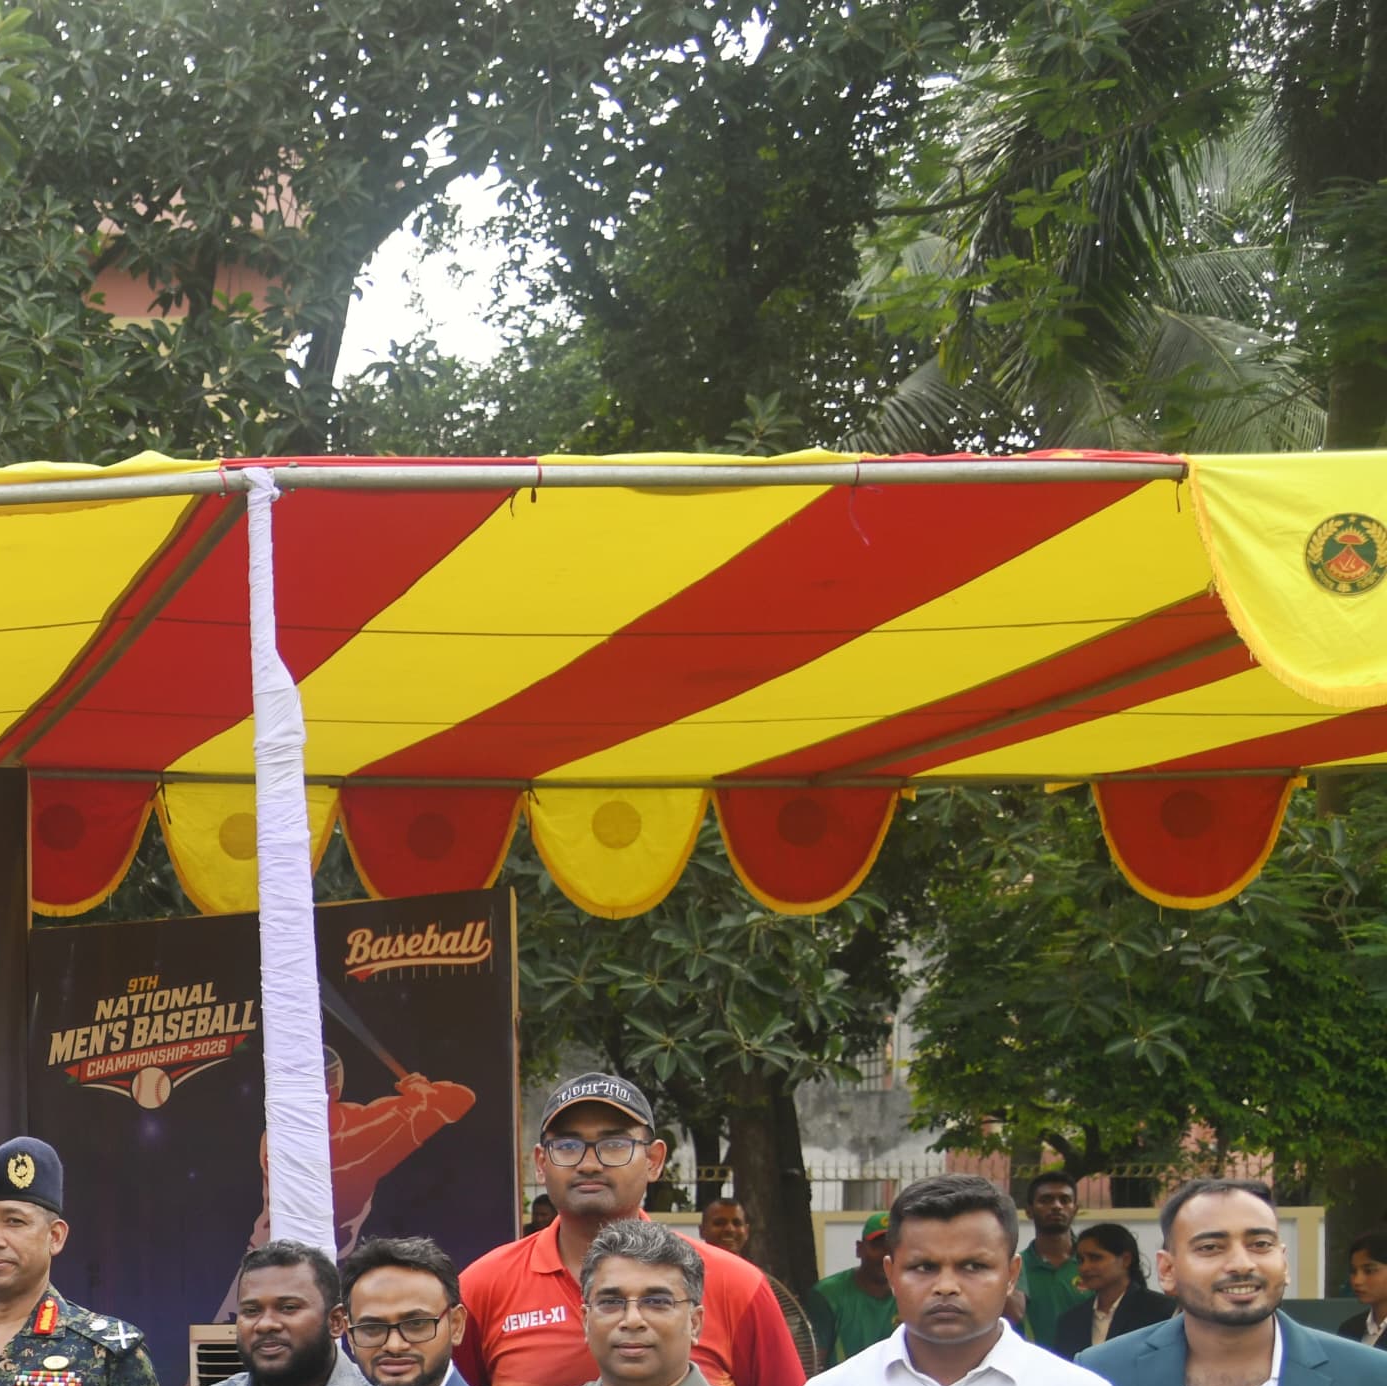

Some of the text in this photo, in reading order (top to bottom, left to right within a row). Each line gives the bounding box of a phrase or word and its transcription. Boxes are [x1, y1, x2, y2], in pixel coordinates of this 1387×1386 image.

[345, 920, 492, 969] Baseball
[94, 982, 218, 1022] NATIONAL
[127, 975, 160, 993] 9TH
[48, 1000, 258, 1067] MEN'S BASEBALL
[86, 1039, 228, 1078] CHAMPIONSHIP-2026
[501, 1305, 566, 1333] JEWEL-XI
